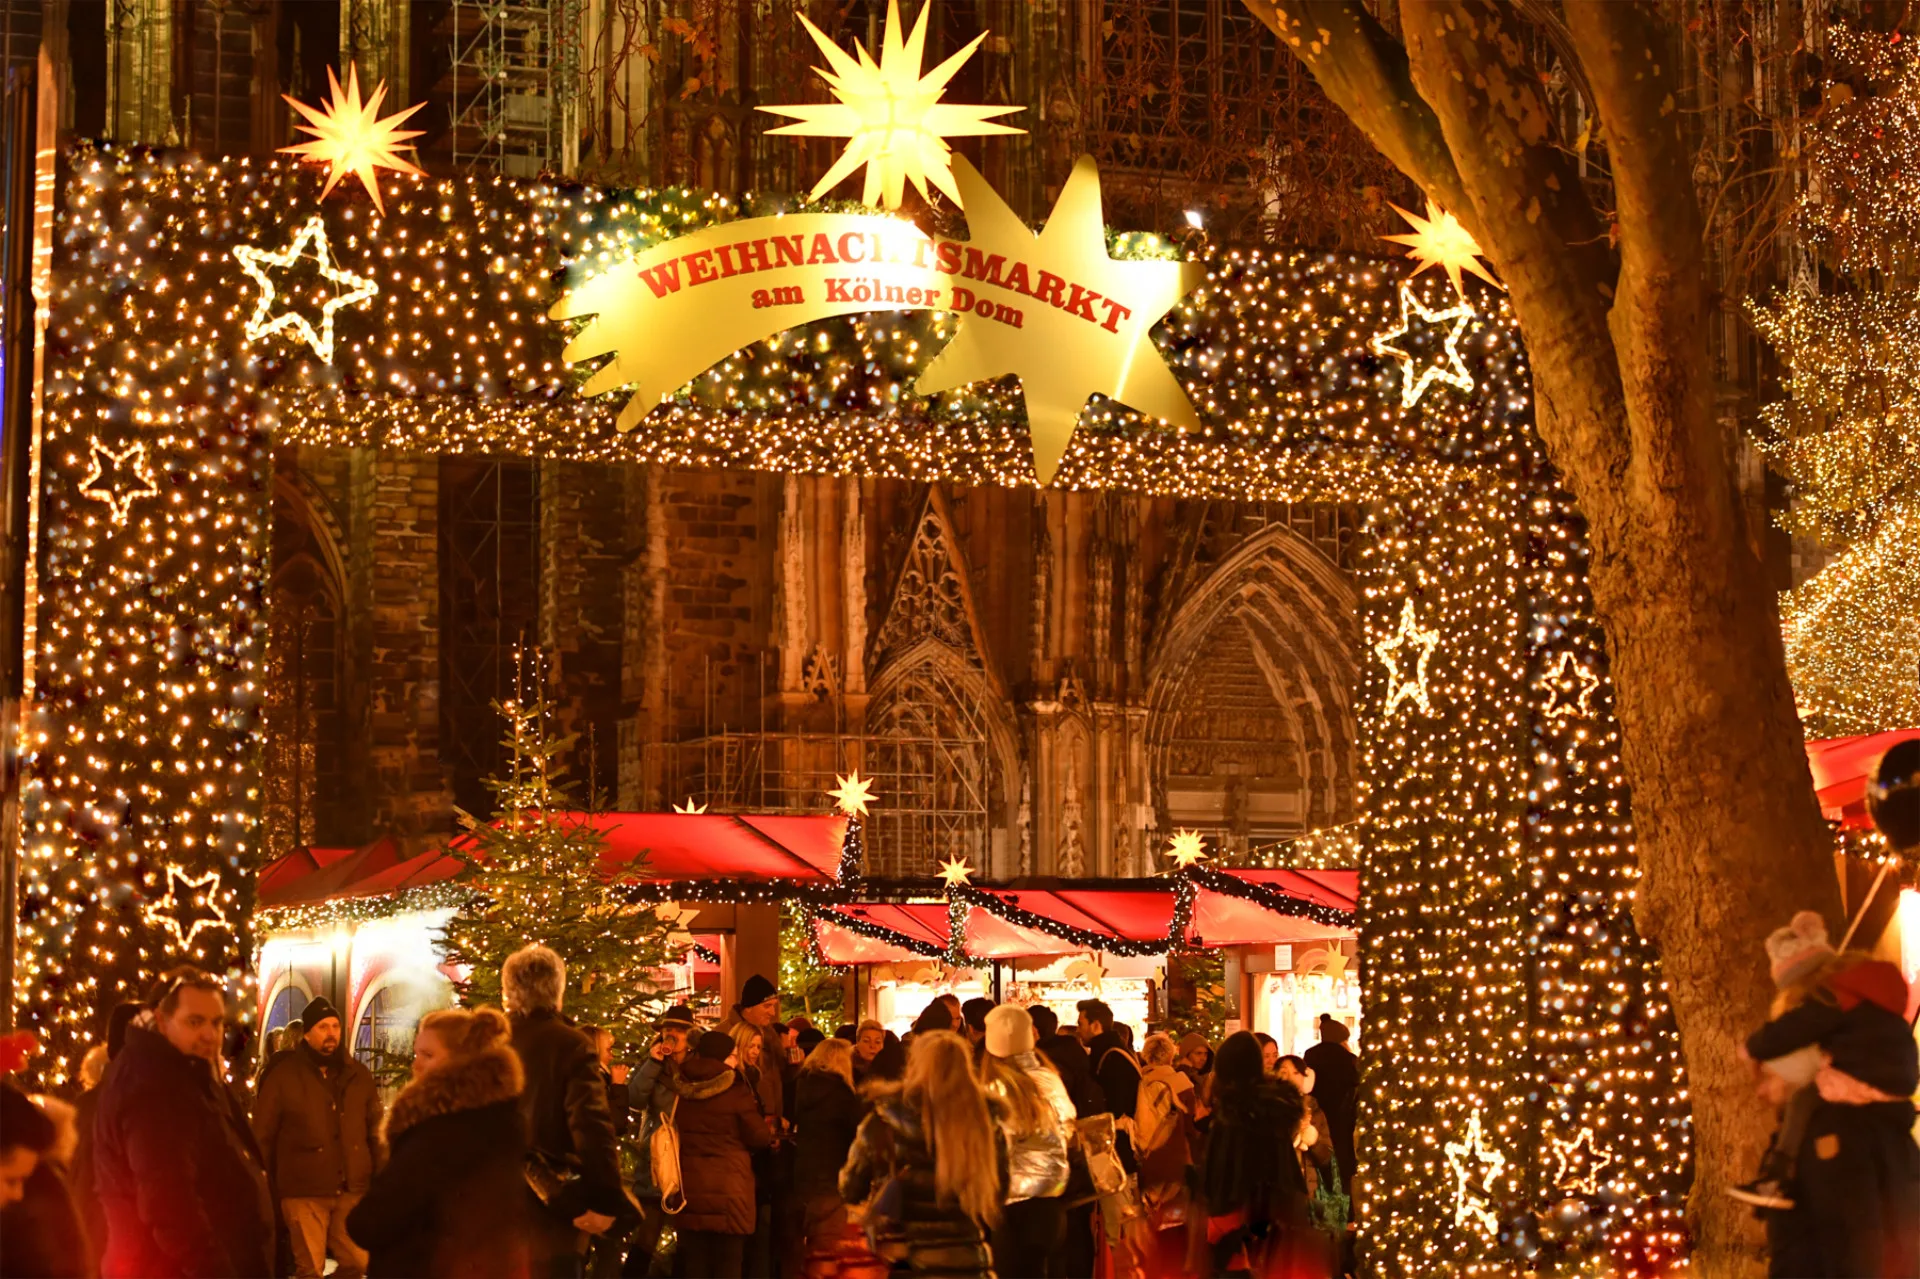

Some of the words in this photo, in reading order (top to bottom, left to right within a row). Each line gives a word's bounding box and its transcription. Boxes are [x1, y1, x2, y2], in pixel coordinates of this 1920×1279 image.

[751, 285, 805, 309] am
[824, 277, 941, 307] Kölner
[949, 286, 1024, 329] Dom
